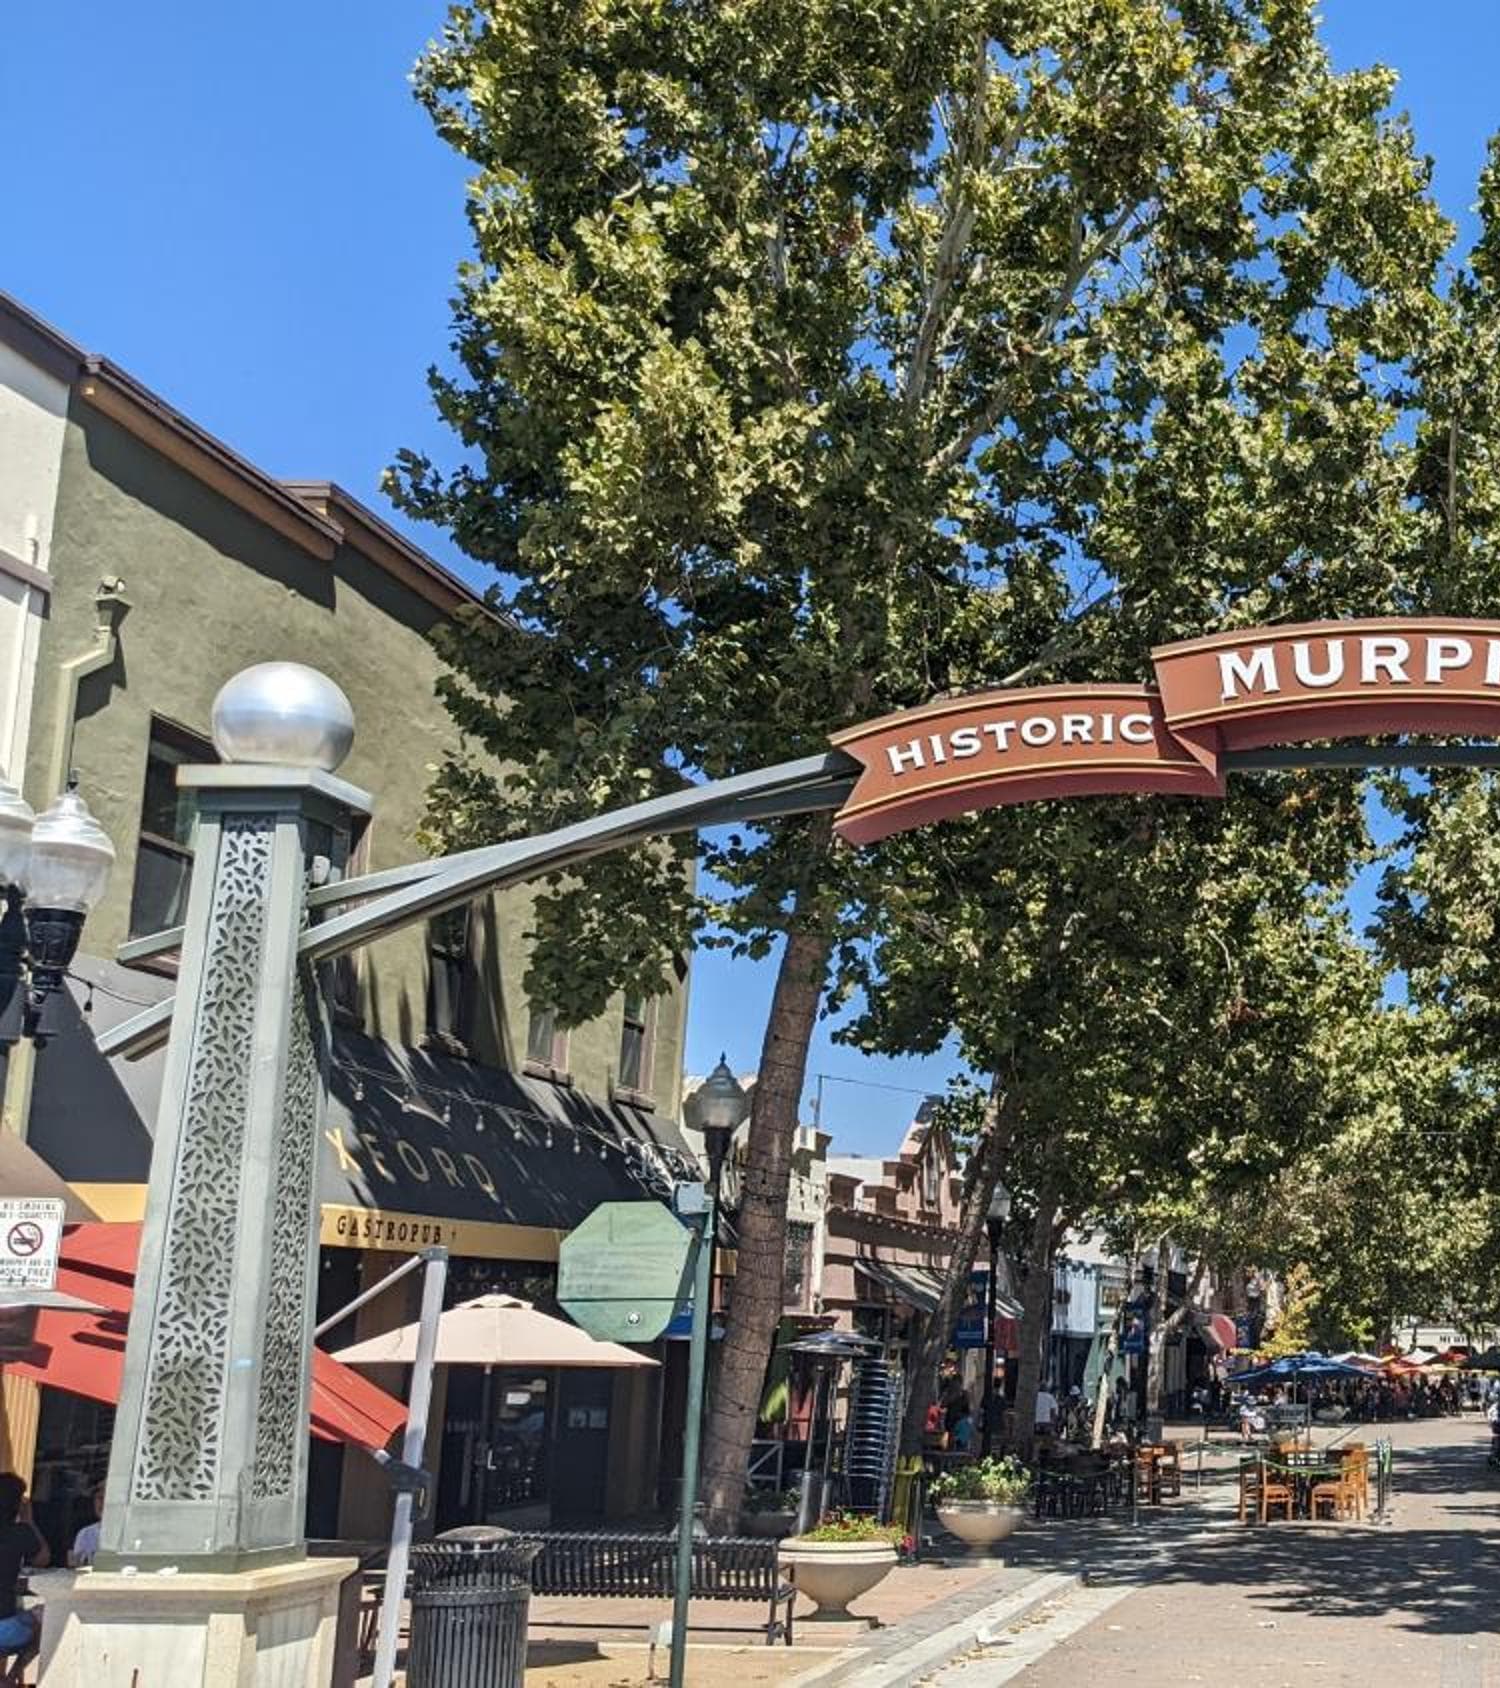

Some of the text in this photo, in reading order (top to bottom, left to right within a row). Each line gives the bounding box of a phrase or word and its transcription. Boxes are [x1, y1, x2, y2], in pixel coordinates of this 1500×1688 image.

[885, 713, 1155, 777] HISTORIC
[325, 1127, 498, 1201] XFORD
[336, 1215, 443, 1246] GASTROPUB
[0, 1267, 23, 1277] MOKE
